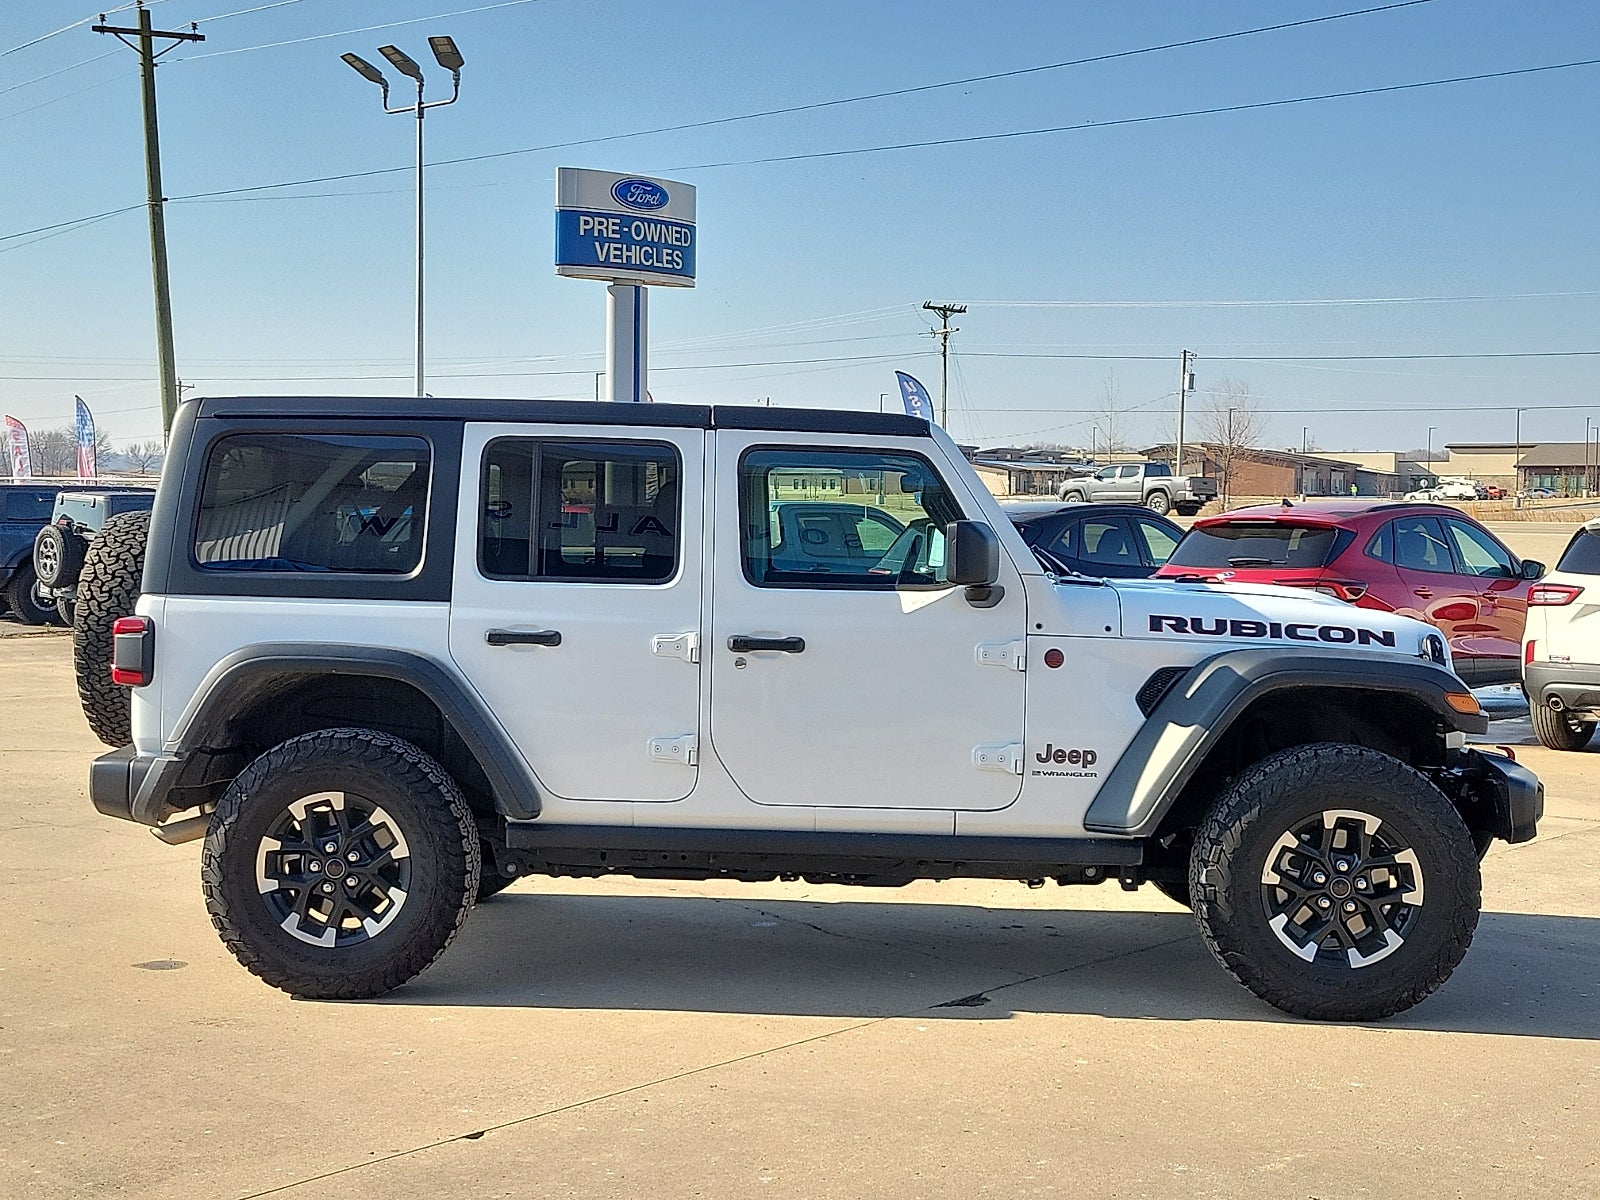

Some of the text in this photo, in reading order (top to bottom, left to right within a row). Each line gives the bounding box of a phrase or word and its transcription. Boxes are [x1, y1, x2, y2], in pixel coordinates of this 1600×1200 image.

[627, 184, 660, 205] Ford
[579, 216, 691, 247] PRE-OWNED
[594, 241, 683, 270] VEHICLES
[1149, 614, 1396, 647] RUBICON
[1036, 743, 1097, 769] Jeep
[1041, 770, 1098, 778] WRANGLER
